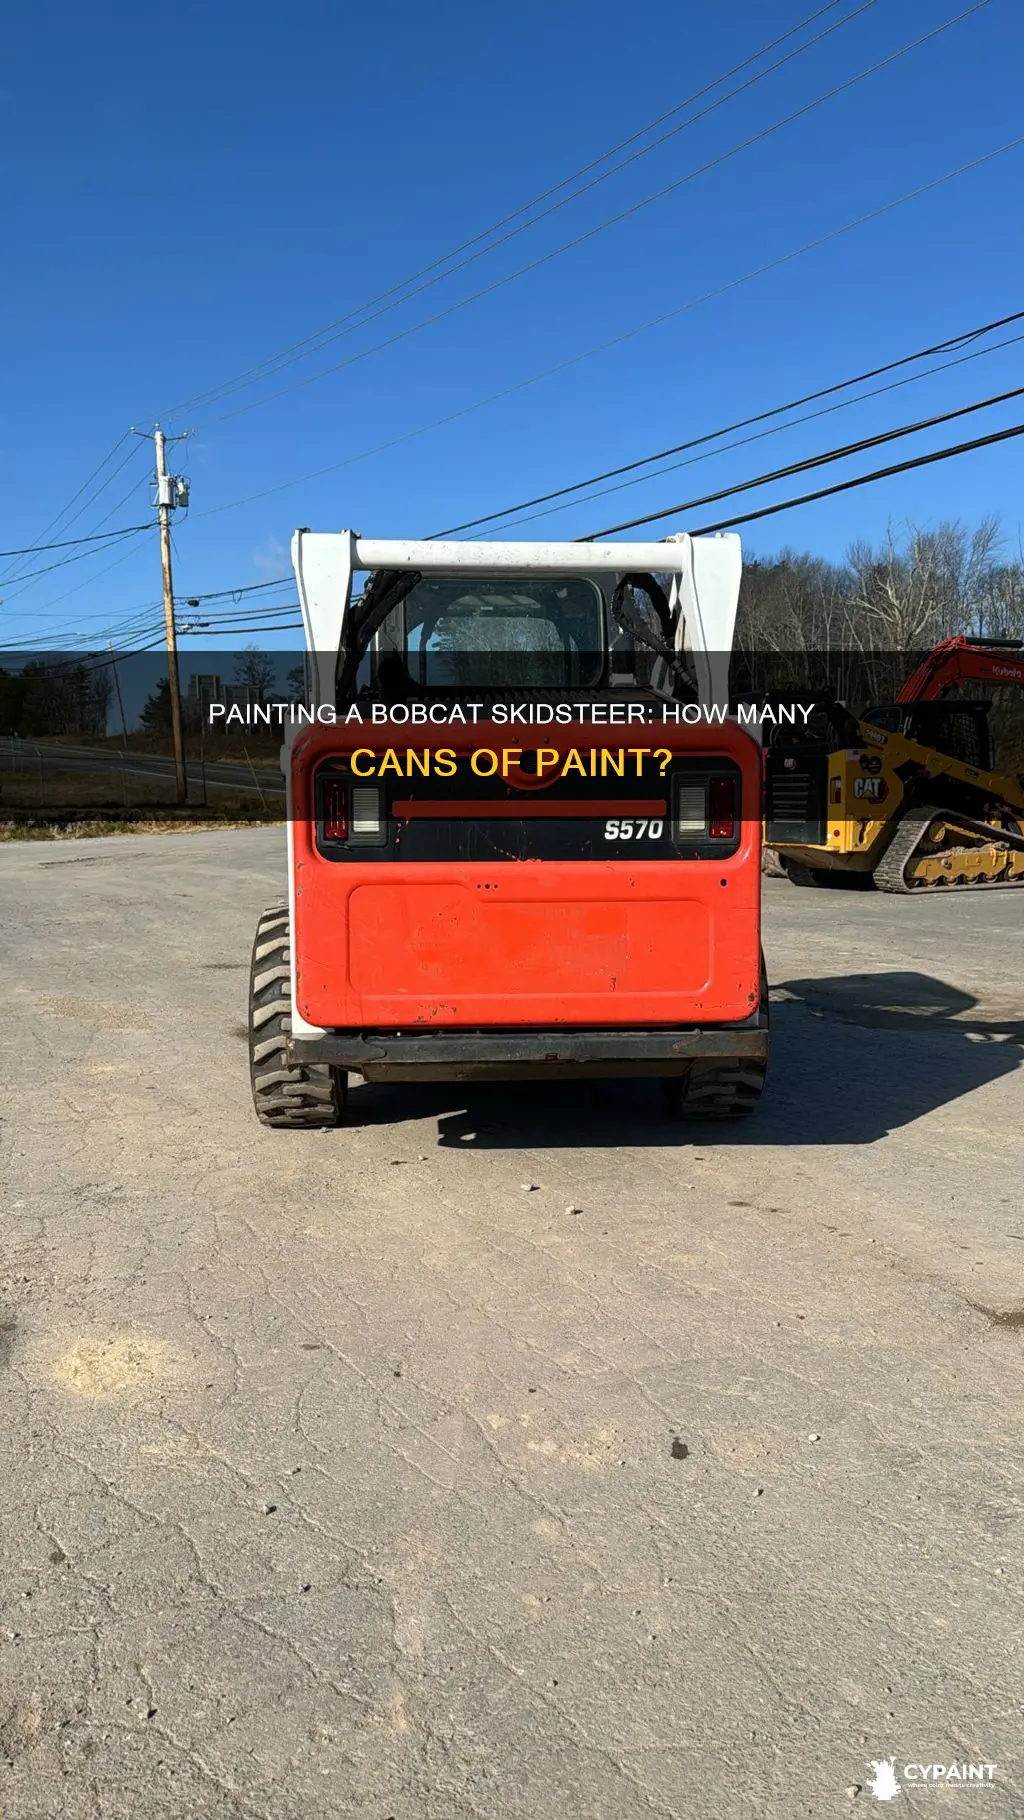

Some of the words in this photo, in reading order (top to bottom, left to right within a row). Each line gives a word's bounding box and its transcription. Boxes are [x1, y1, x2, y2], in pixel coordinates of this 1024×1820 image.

[992, 665, 1022, 678] Kubota
[854, 778, 881, 798] CAT
[604, 819, 664, 840] S570
